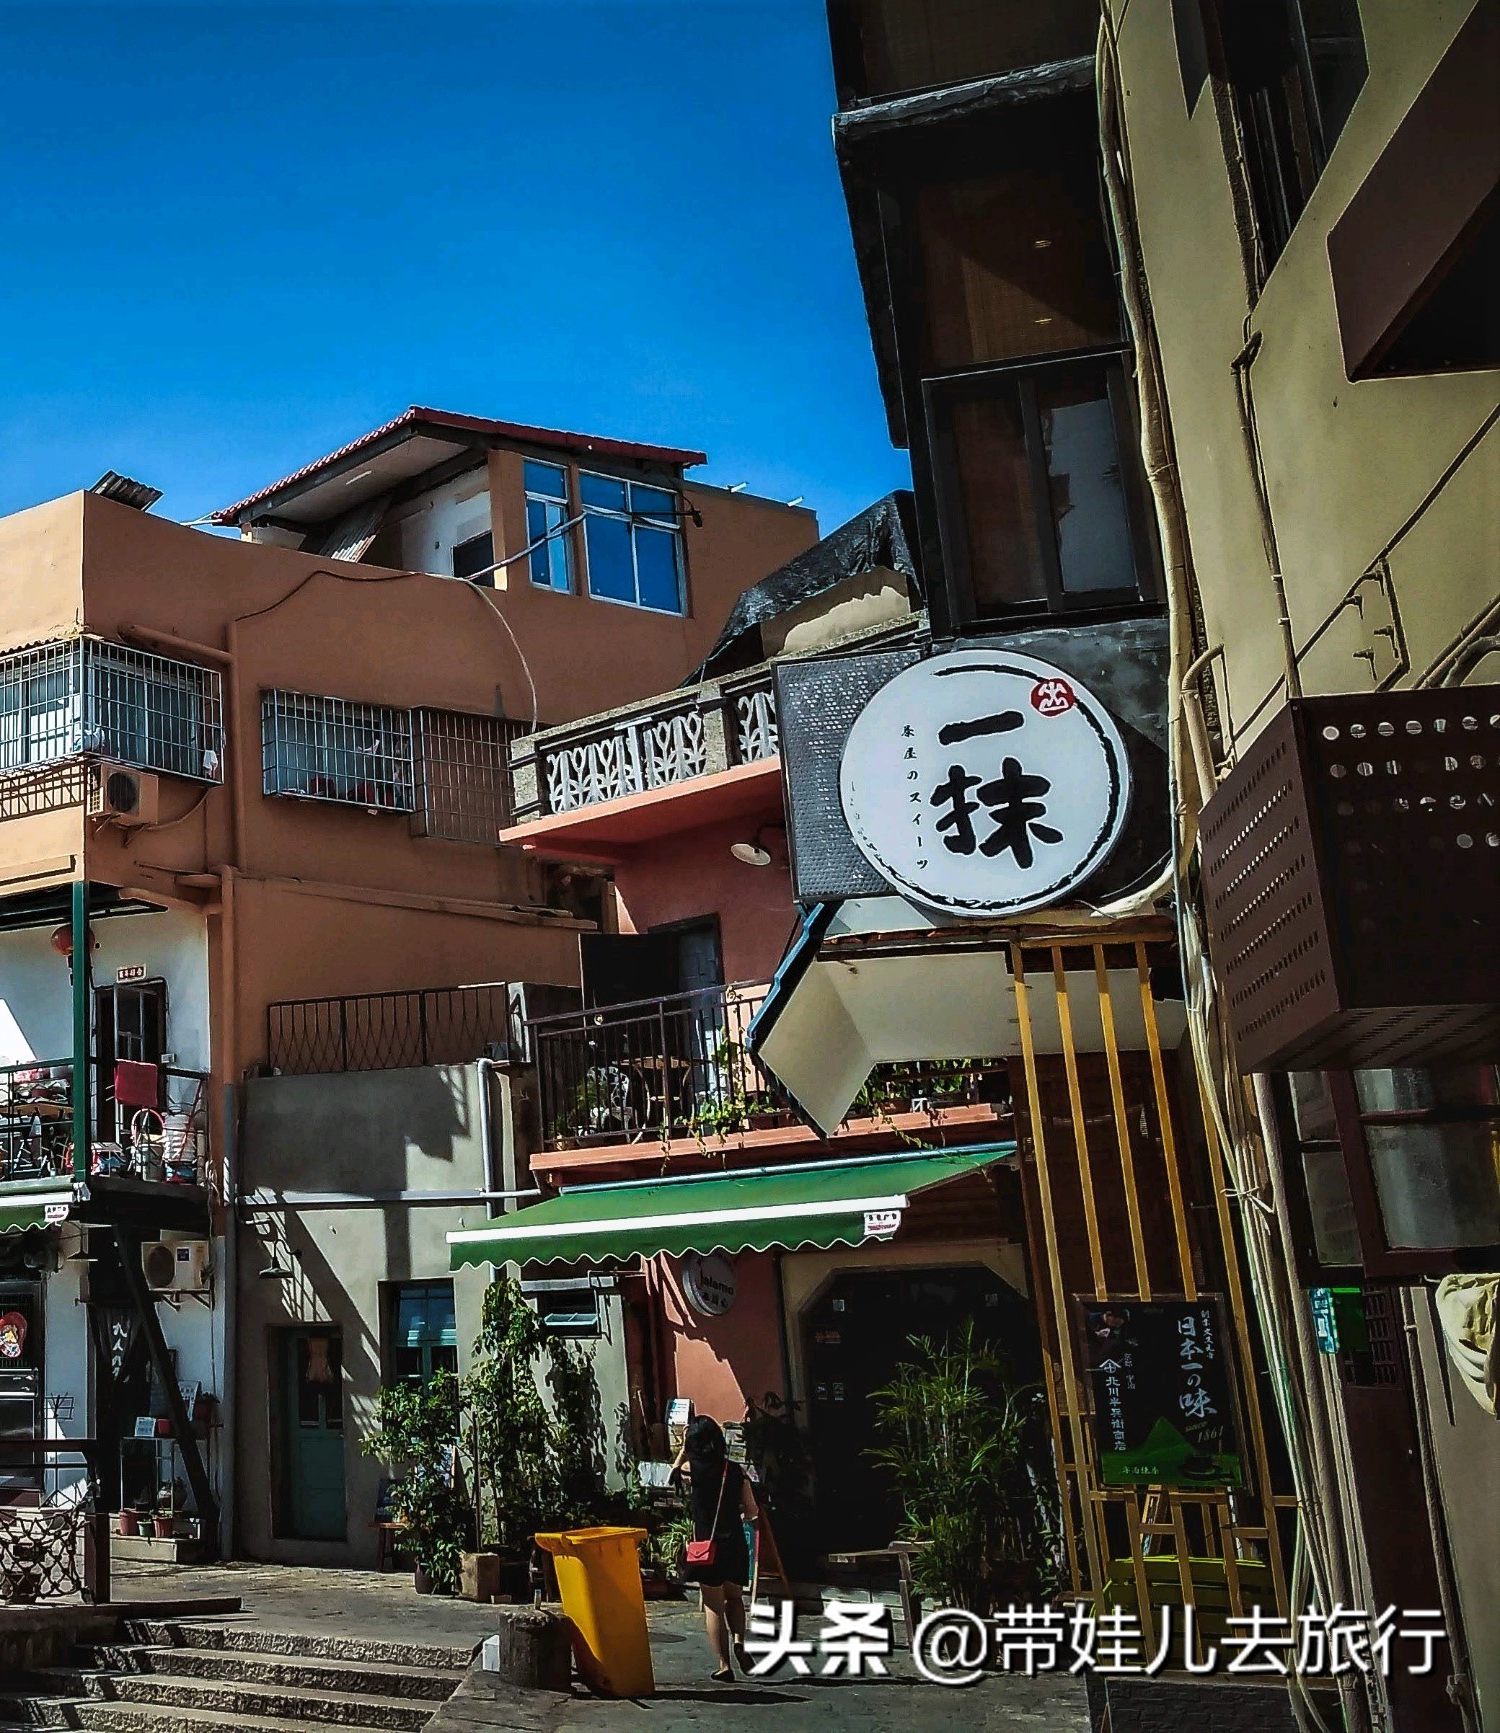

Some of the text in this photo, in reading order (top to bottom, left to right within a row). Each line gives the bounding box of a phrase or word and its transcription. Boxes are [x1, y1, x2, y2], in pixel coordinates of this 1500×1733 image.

[929, 709, 1064, 870] 一抹
[1177, 1316, 1218, 1418] 日本一の味
